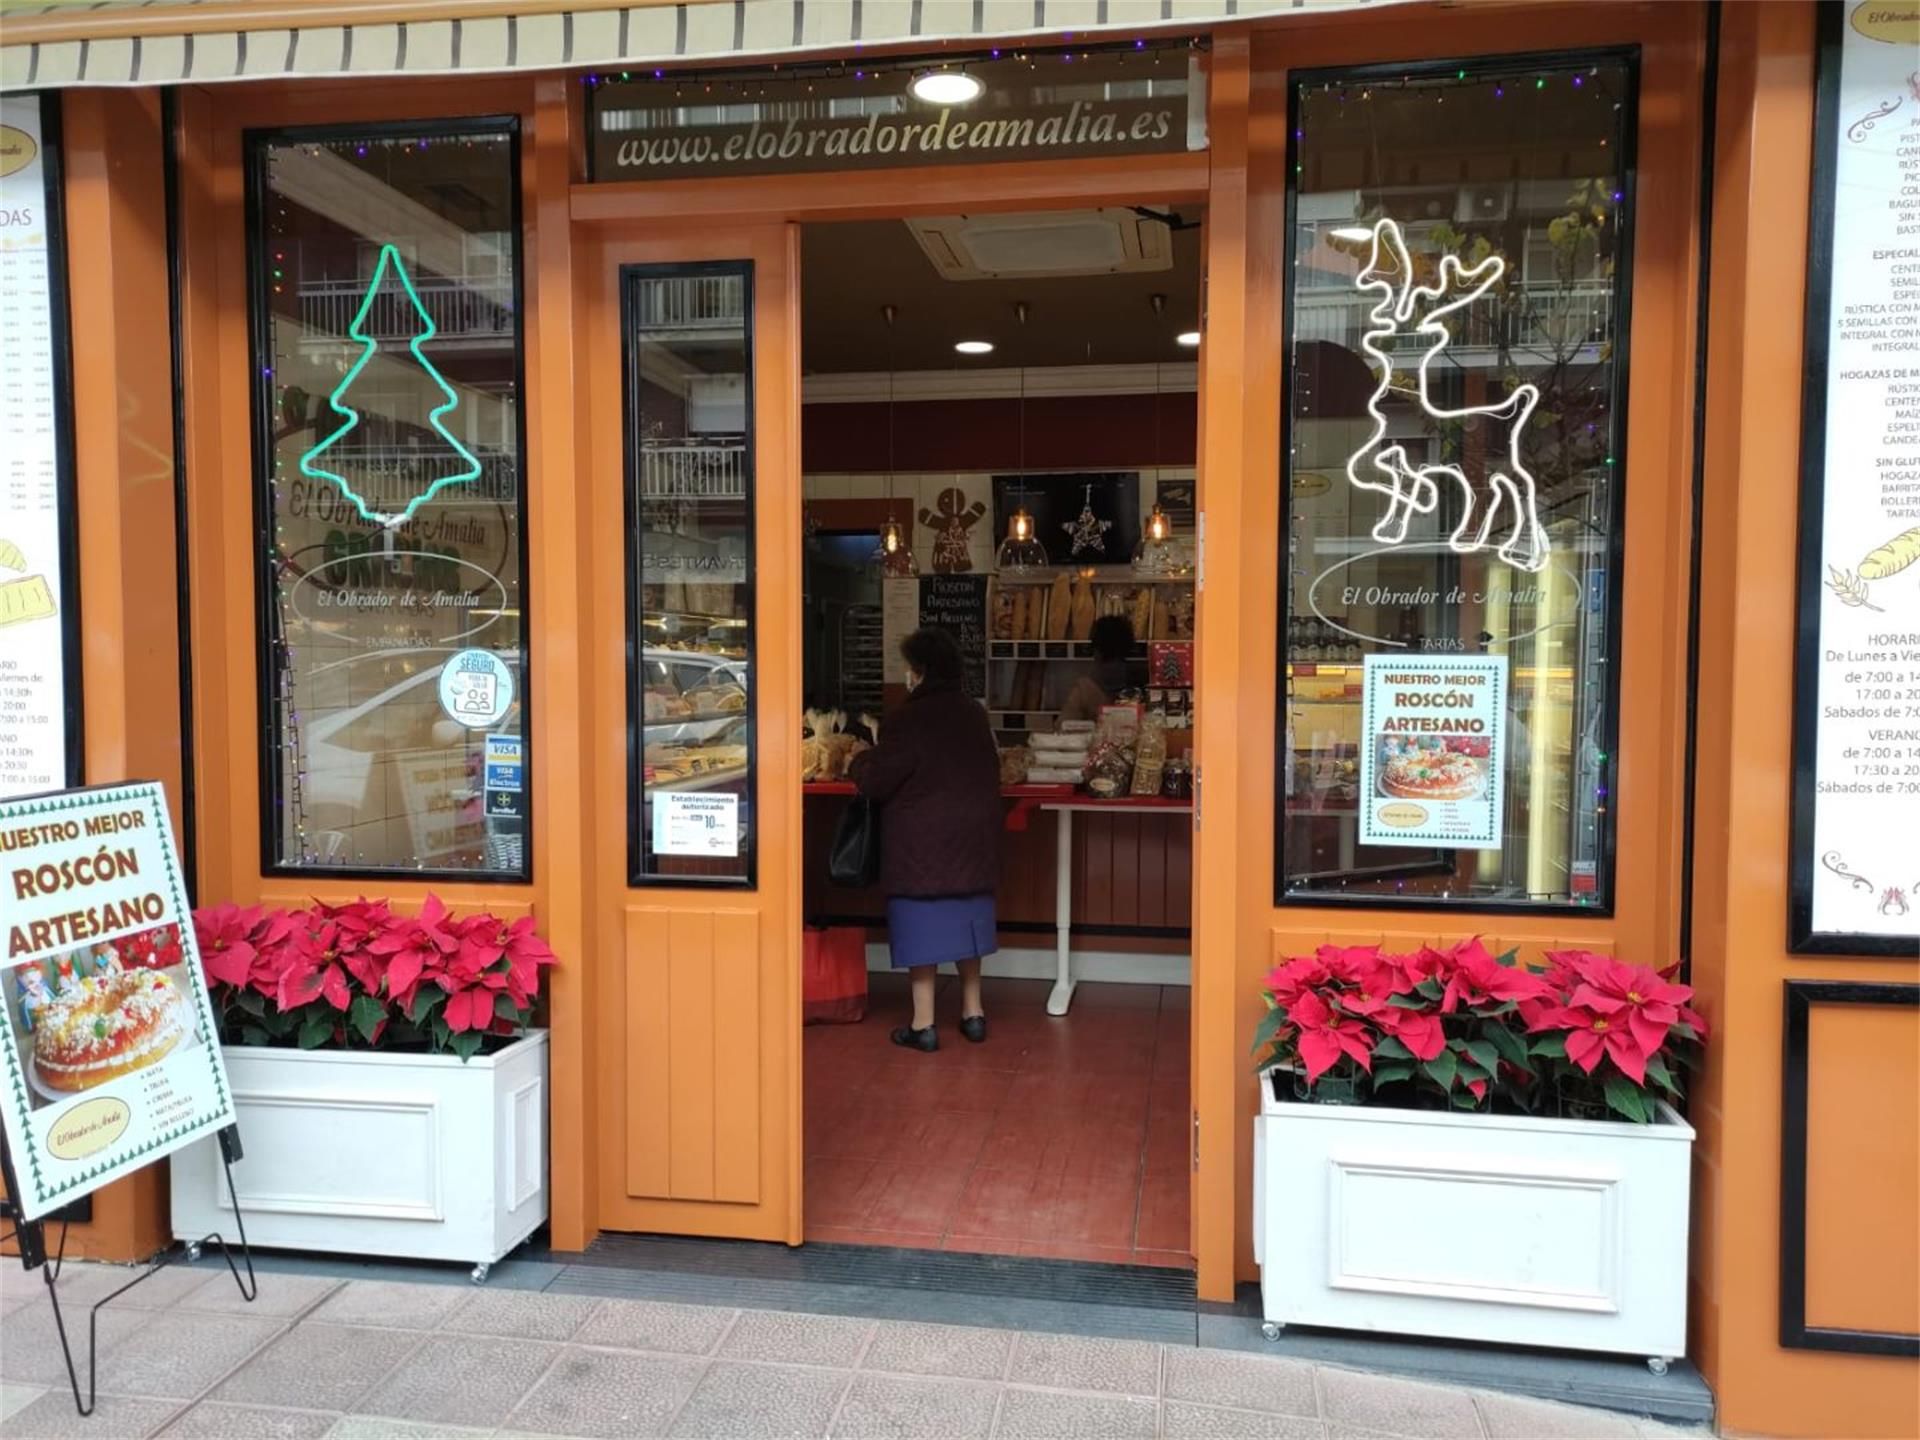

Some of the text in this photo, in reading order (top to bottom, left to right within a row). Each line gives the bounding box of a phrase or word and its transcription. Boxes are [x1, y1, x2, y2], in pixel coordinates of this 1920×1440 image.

[616, 102, 1172, 166] www.elobradordeamalia.es
[1896, 147, 1920, 157] CAN
[1894, 290, 1920, 300] ESPE
[1888, 304, 1912, 313] CON
[1846, 316, 1894, 328] SEMILLAS
[1895, 316, 1918, 326] CON
[1840, 329, 1914, 340] INTEGRAL CON
[1840, 370, 1890, 380] HOGAZAS
[1894, 369, 1908, 378] DE
[1876, 458, 1893, 467] SIN
[317, 590, 480, 607] El Obrador de Amalia
[1342, 587, 1360, 605] El
[1365, 587, 1440, 604] Obrador
[1446, 586, 1466, 604] de
[1420, 638, 1465, 650] TARTAS
[1826, 650, 1844, 662] De
[1848, 650, 1886, 662] Lunes
[1890, 652, 1898, 662] a
[460, 658, 495, 672] SEGURO
[1384, 674, 1486, 686] NUESTRO MEJOR
[1844, 672, 1862, 683] de
[1865, 672, 1893, 683] 7:00
[1896, 674, 1904, 682] a
[1394, 690, 1474, 708] ROSCÓN
[1856, 689, 1891, 700] 17:00
[1894, 690, 1902, 700] a
[1884, 706, 1901, 718] de
[1383, 716, 1484, 732] ARTESANO
[493, 745, 517, 755] VISA
[1842, 747, 1860, 758] de
[1864, 748, 1891, 758] 7:00
[1894, 750, 1902, 758] a
[1854, 765, 1889, 776] 17:30
[1892, 767, 1900, 776] a
[1876, 782, 1893, 793] de
[671, 795, 735, 804] Establecimiento
[704, 814, 716, 830] 10
[0, 810, 146, 850] UESTRO MEJOR
[12, 844, 140, 900] ROSCÓN
[8, 892, 164, 958] ARTESANO
